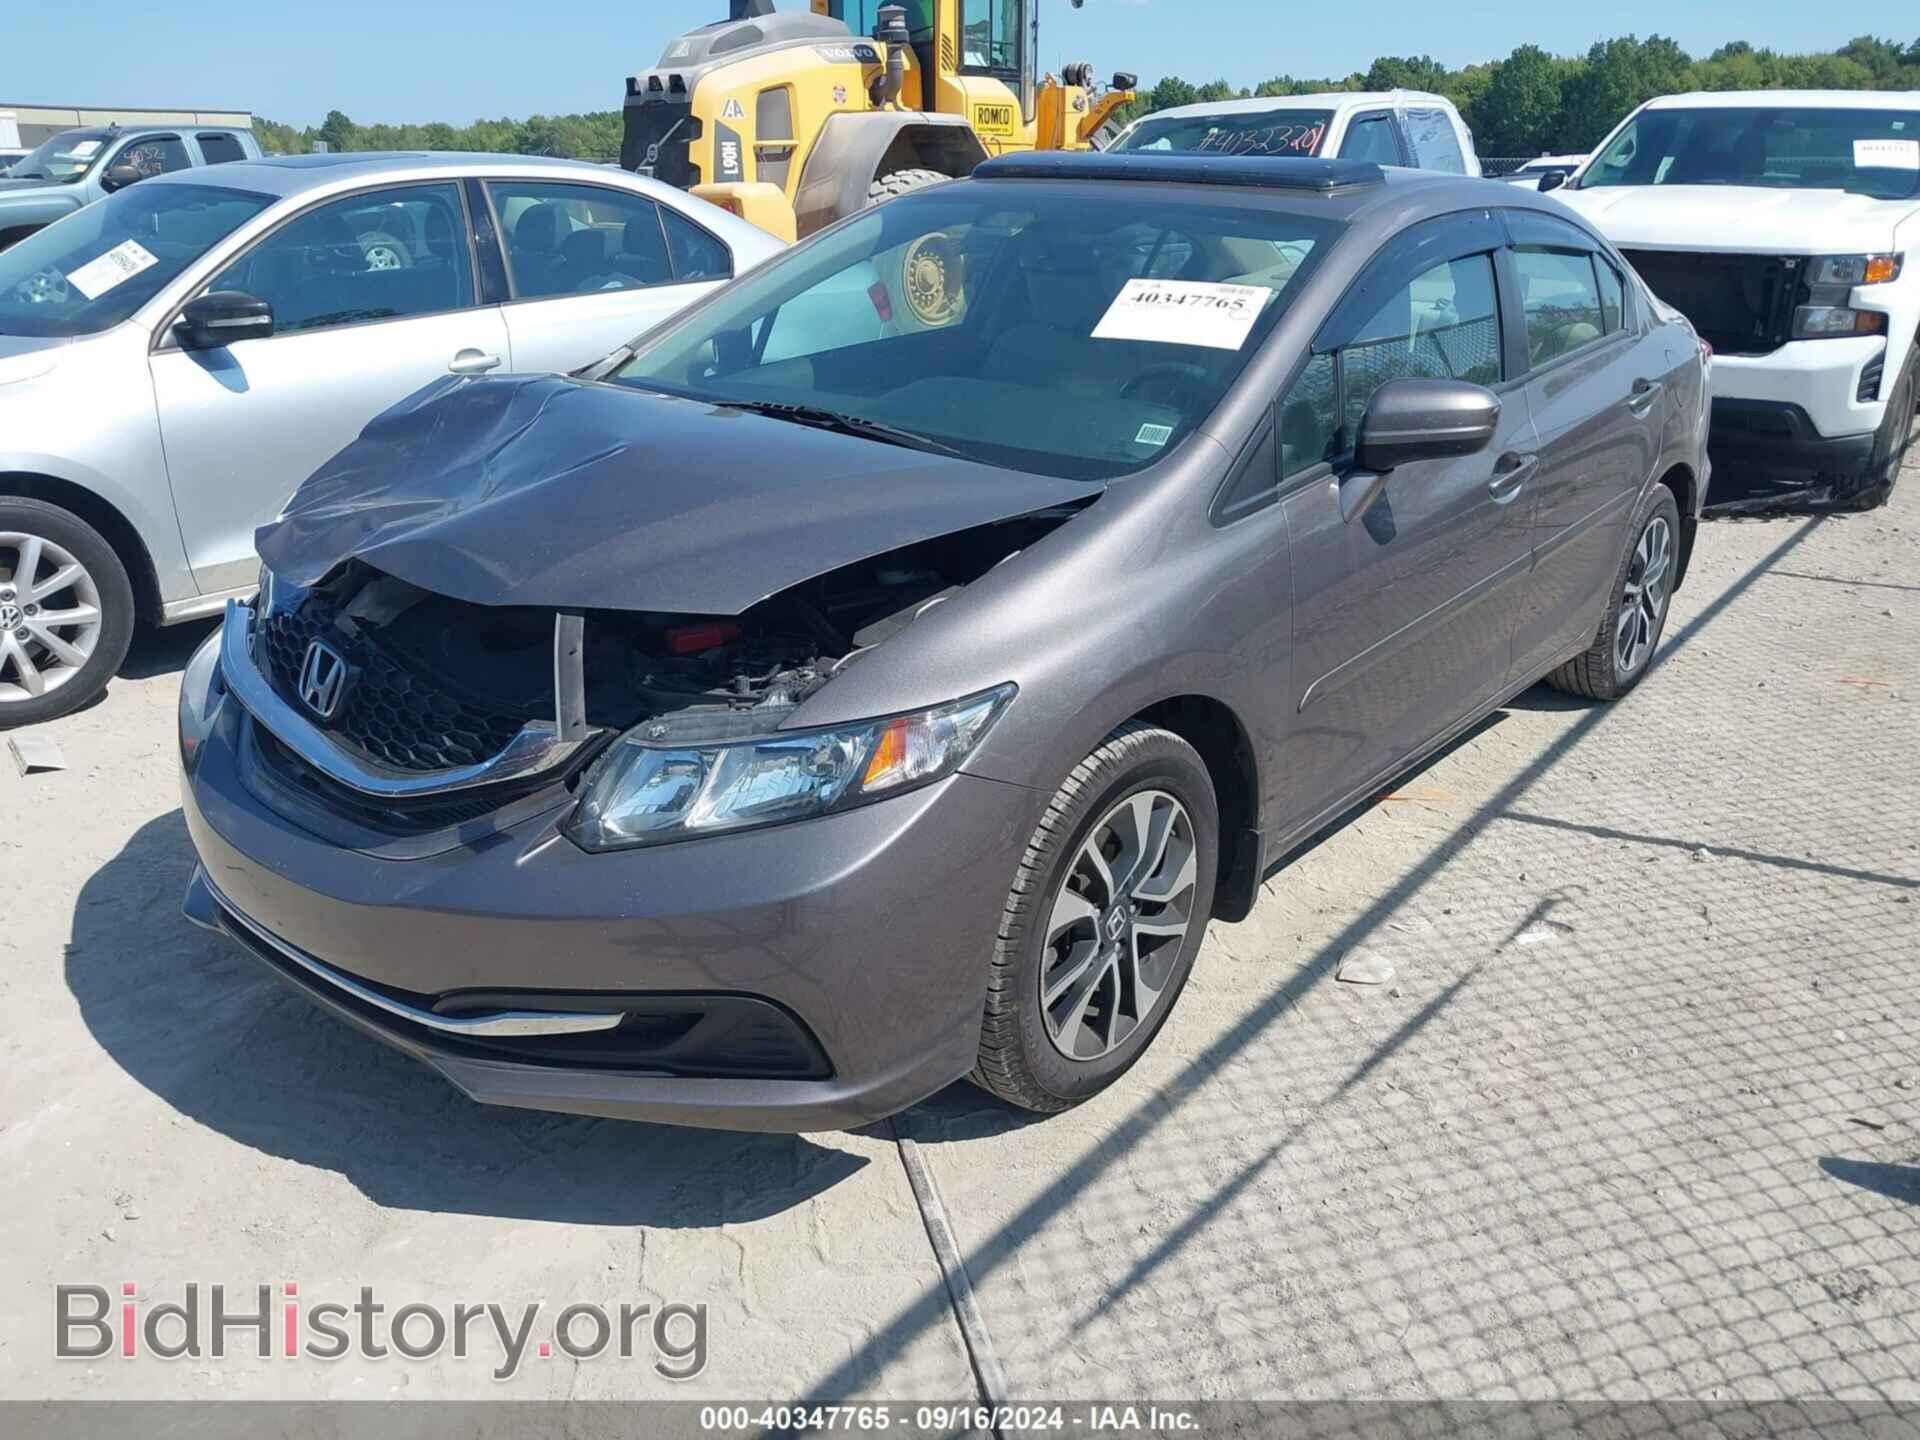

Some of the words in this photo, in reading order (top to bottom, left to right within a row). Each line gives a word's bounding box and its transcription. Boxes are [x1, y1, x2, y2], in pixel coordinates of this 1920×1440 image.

[978, 107, 1009, 125] ROMCO
[720, 140, 739, 175] L90H
[1131, 292, 1248, 311] 40347765
